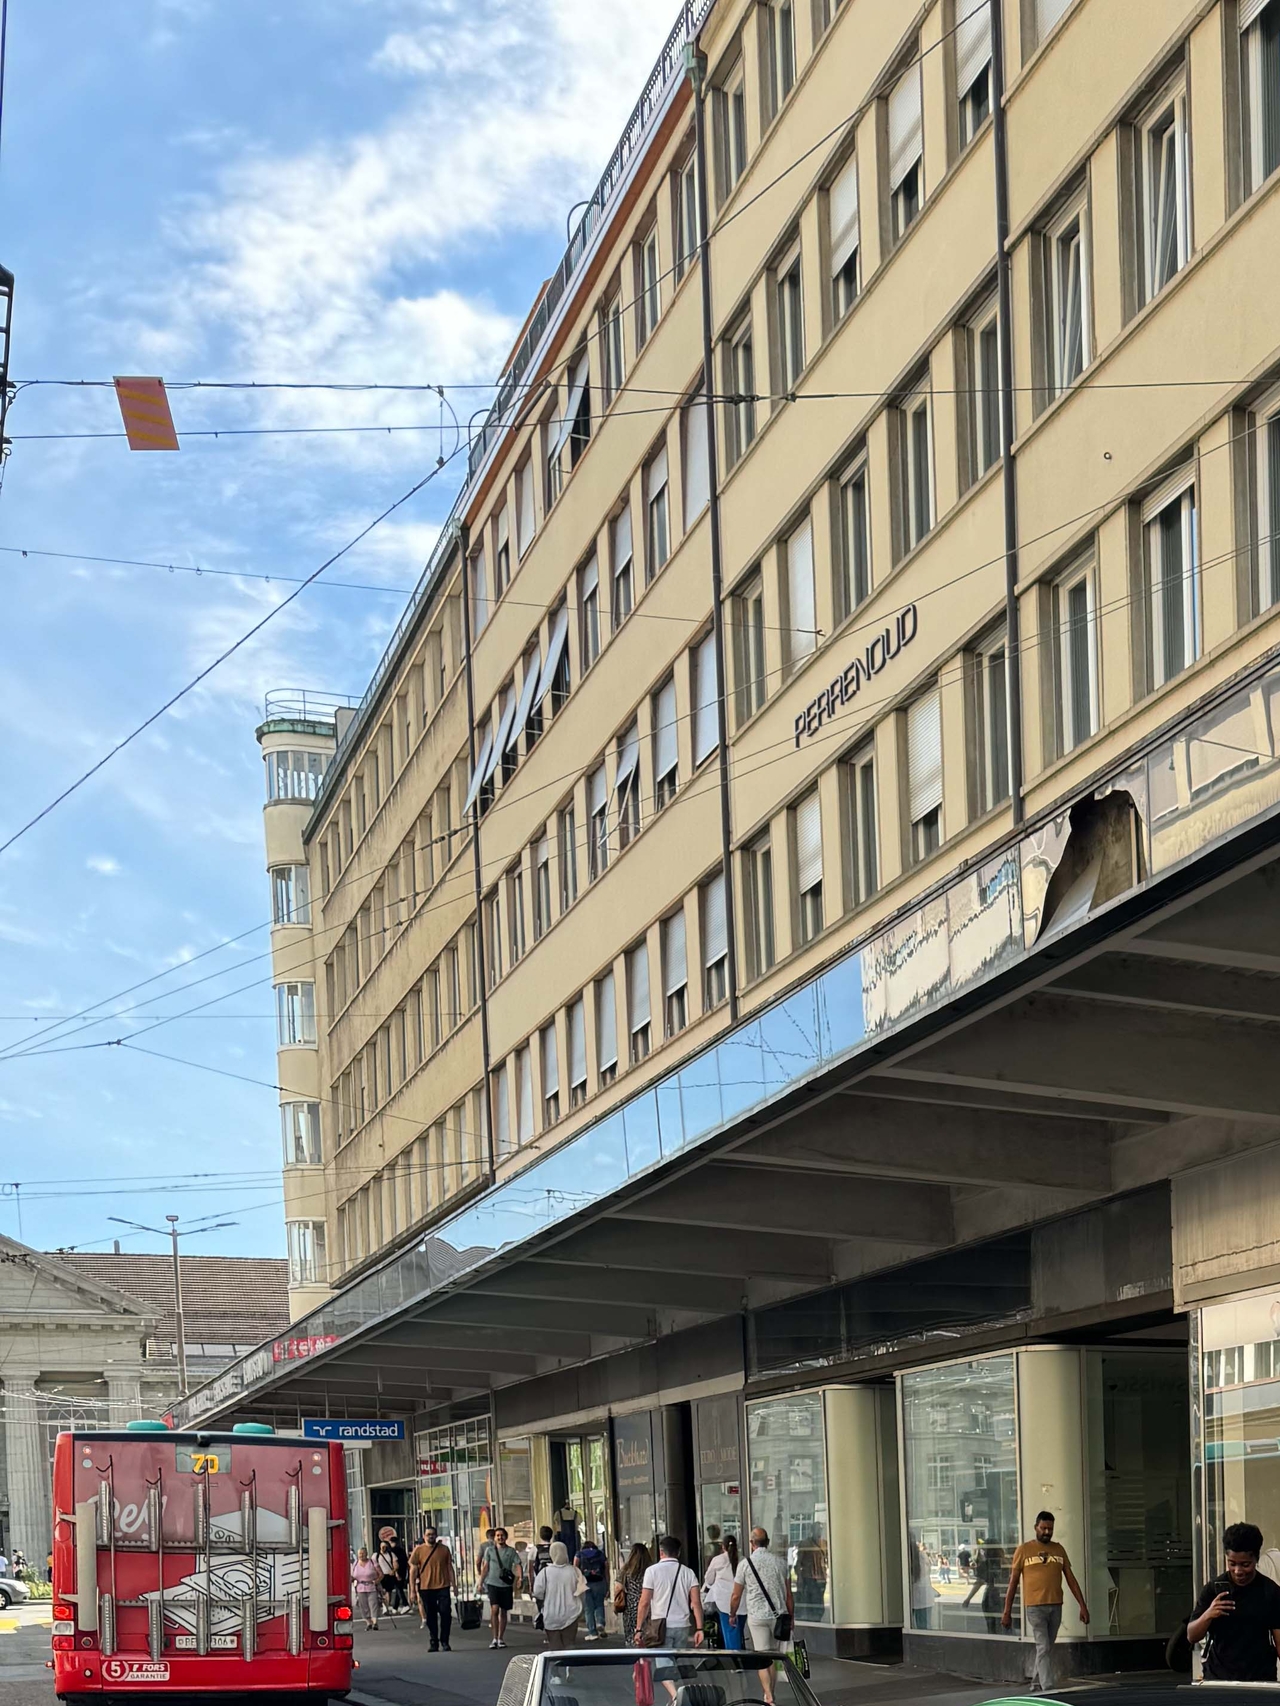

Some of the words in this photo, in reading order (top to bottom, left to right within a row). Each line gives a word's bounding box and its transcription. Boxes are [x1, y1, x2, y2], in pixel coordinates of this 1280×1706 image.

[794, 603, 918, 749] PERRENOUD
[338, 1423, 398, 1437] randstad
[191, 1454, 219, 1474] 70
[110, 1661, 121, 1677] 5
[142, 1664, 165, 1672] FORS
[130, 1672, 167, 1680] GARANTIE
